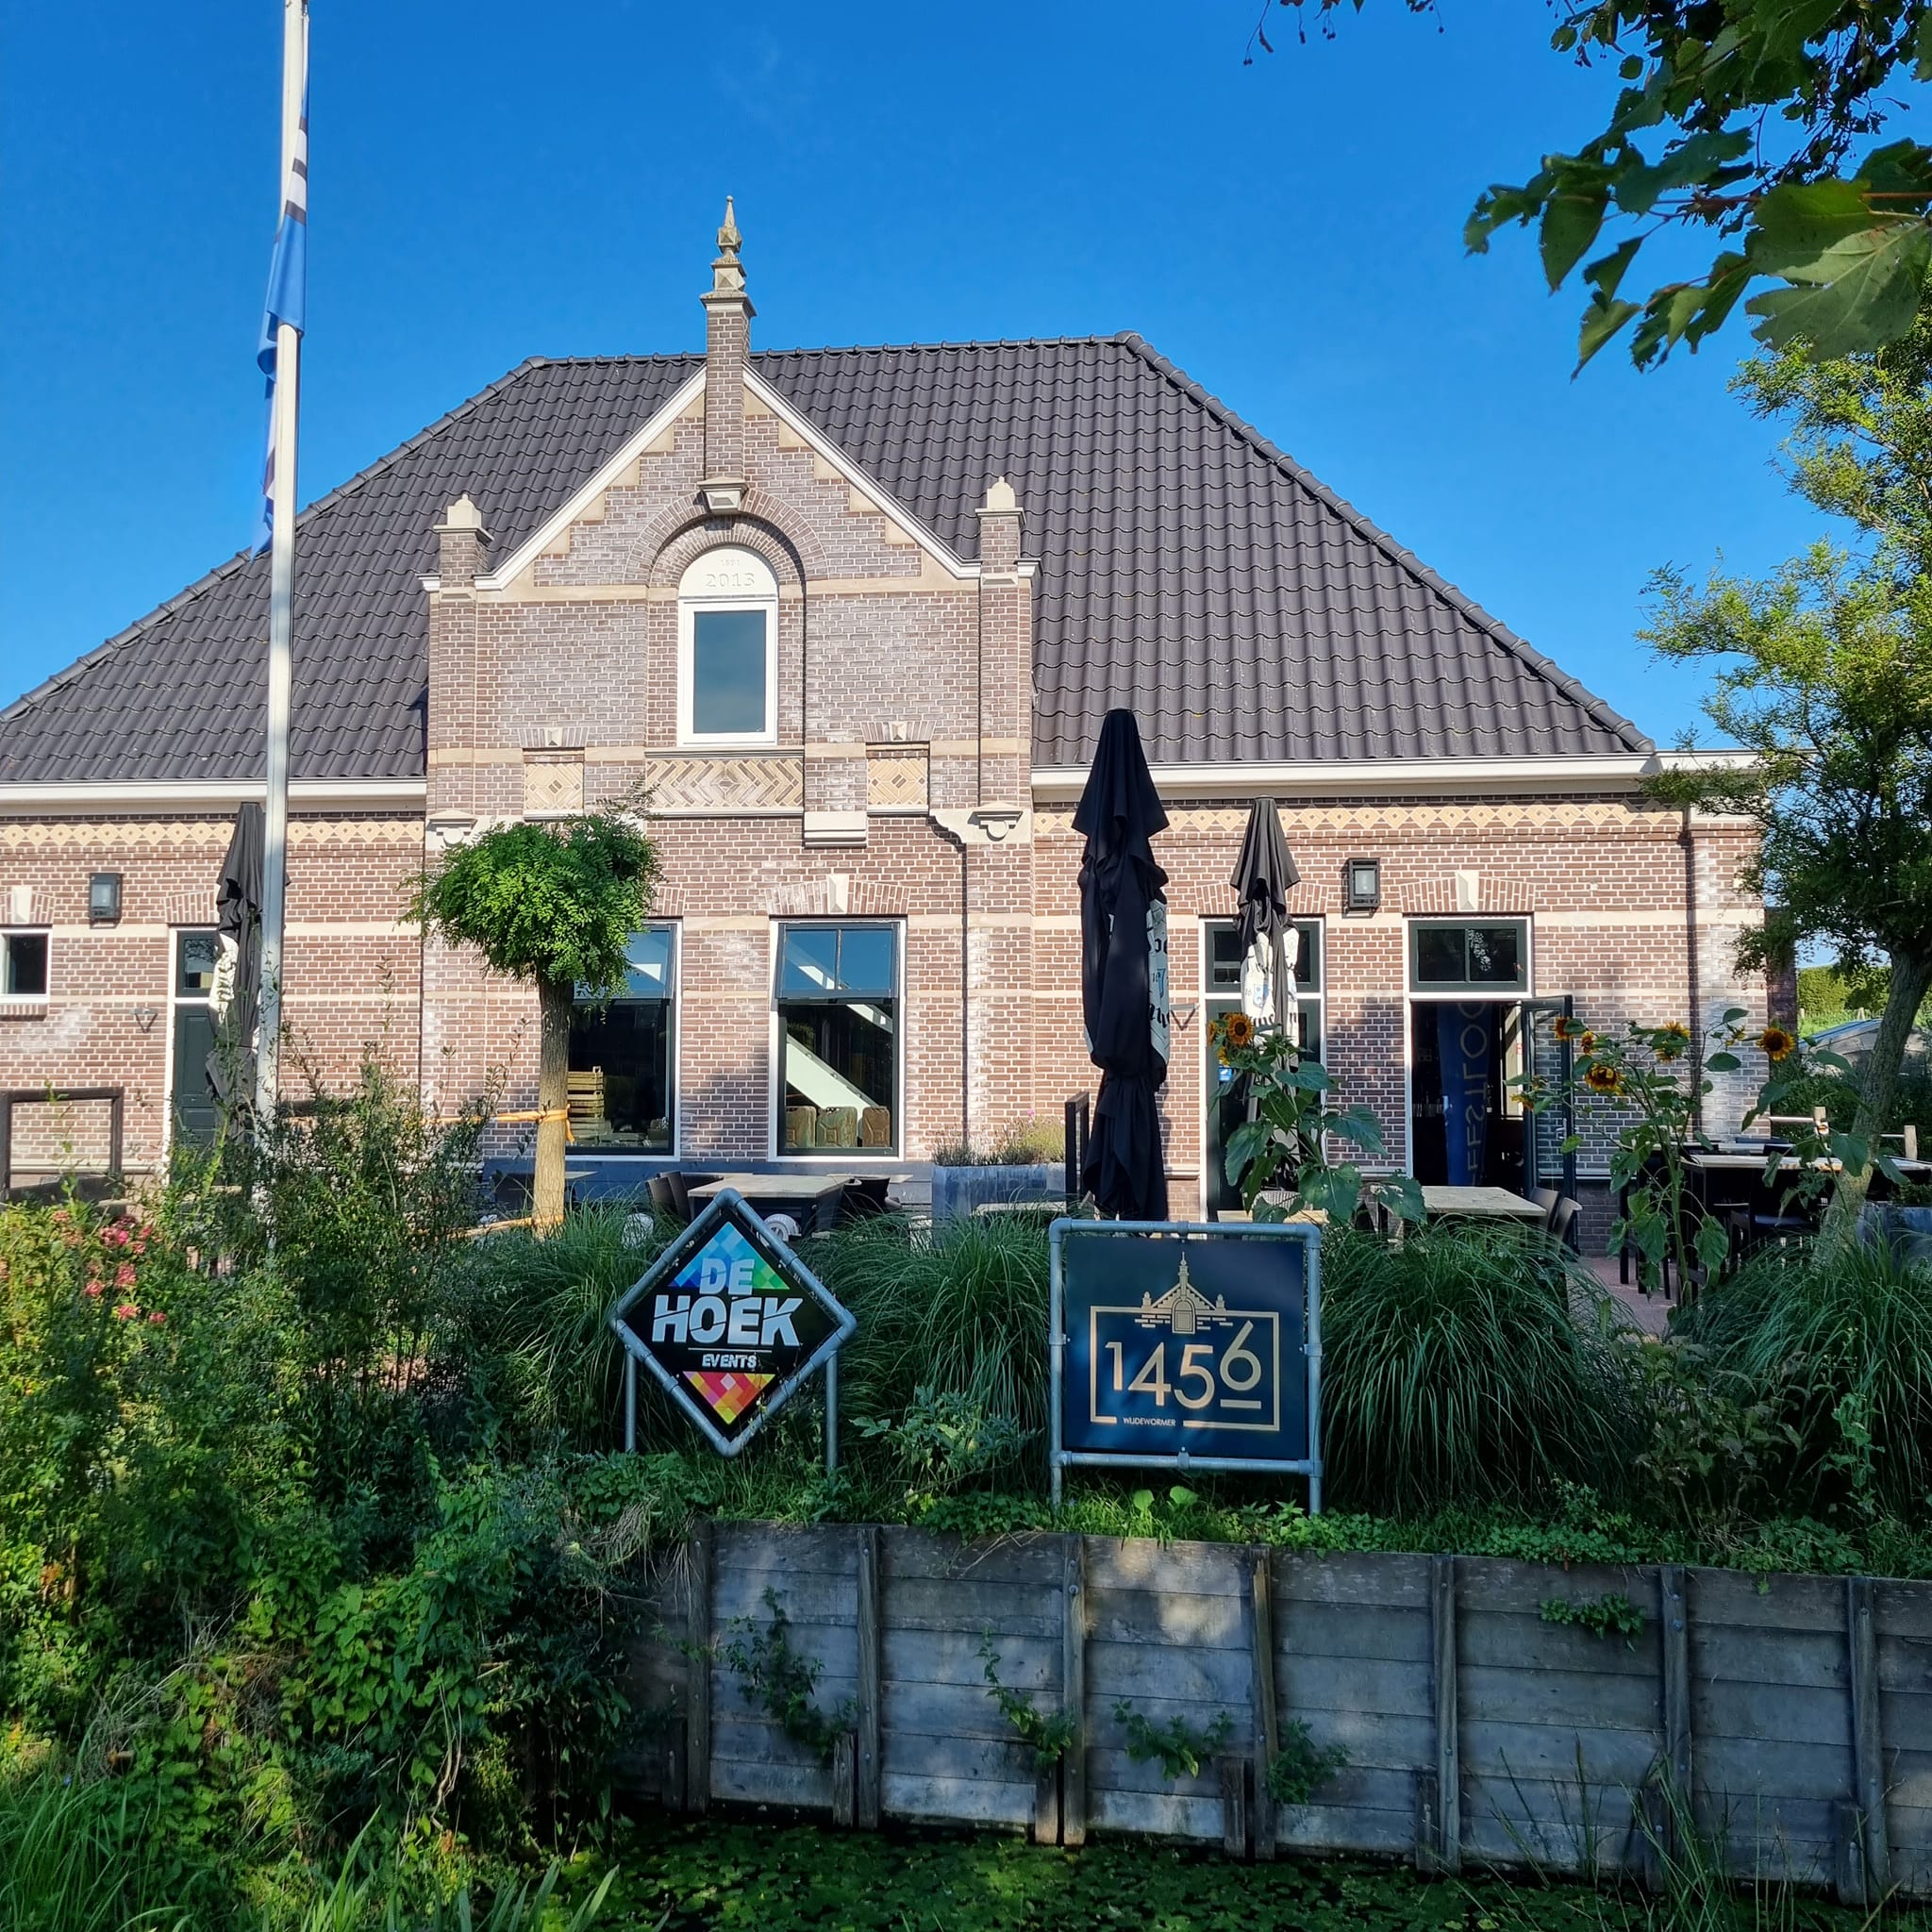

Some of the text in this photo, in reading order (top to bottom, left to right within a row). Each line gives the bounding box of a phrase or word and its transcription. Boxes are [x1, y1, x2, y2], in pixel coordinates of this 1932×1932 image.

[705, 573, 755, 588] 2013
[698, 1257, 755, 1295] DE
[651, 1294, 803, 1347] HOEK
[701, 1353, 758, 1369] EVENTS
[1105, 1320, 1262, 1409] 1456
[1123, 1416, 1176, 1427] WIJDEWORMER
